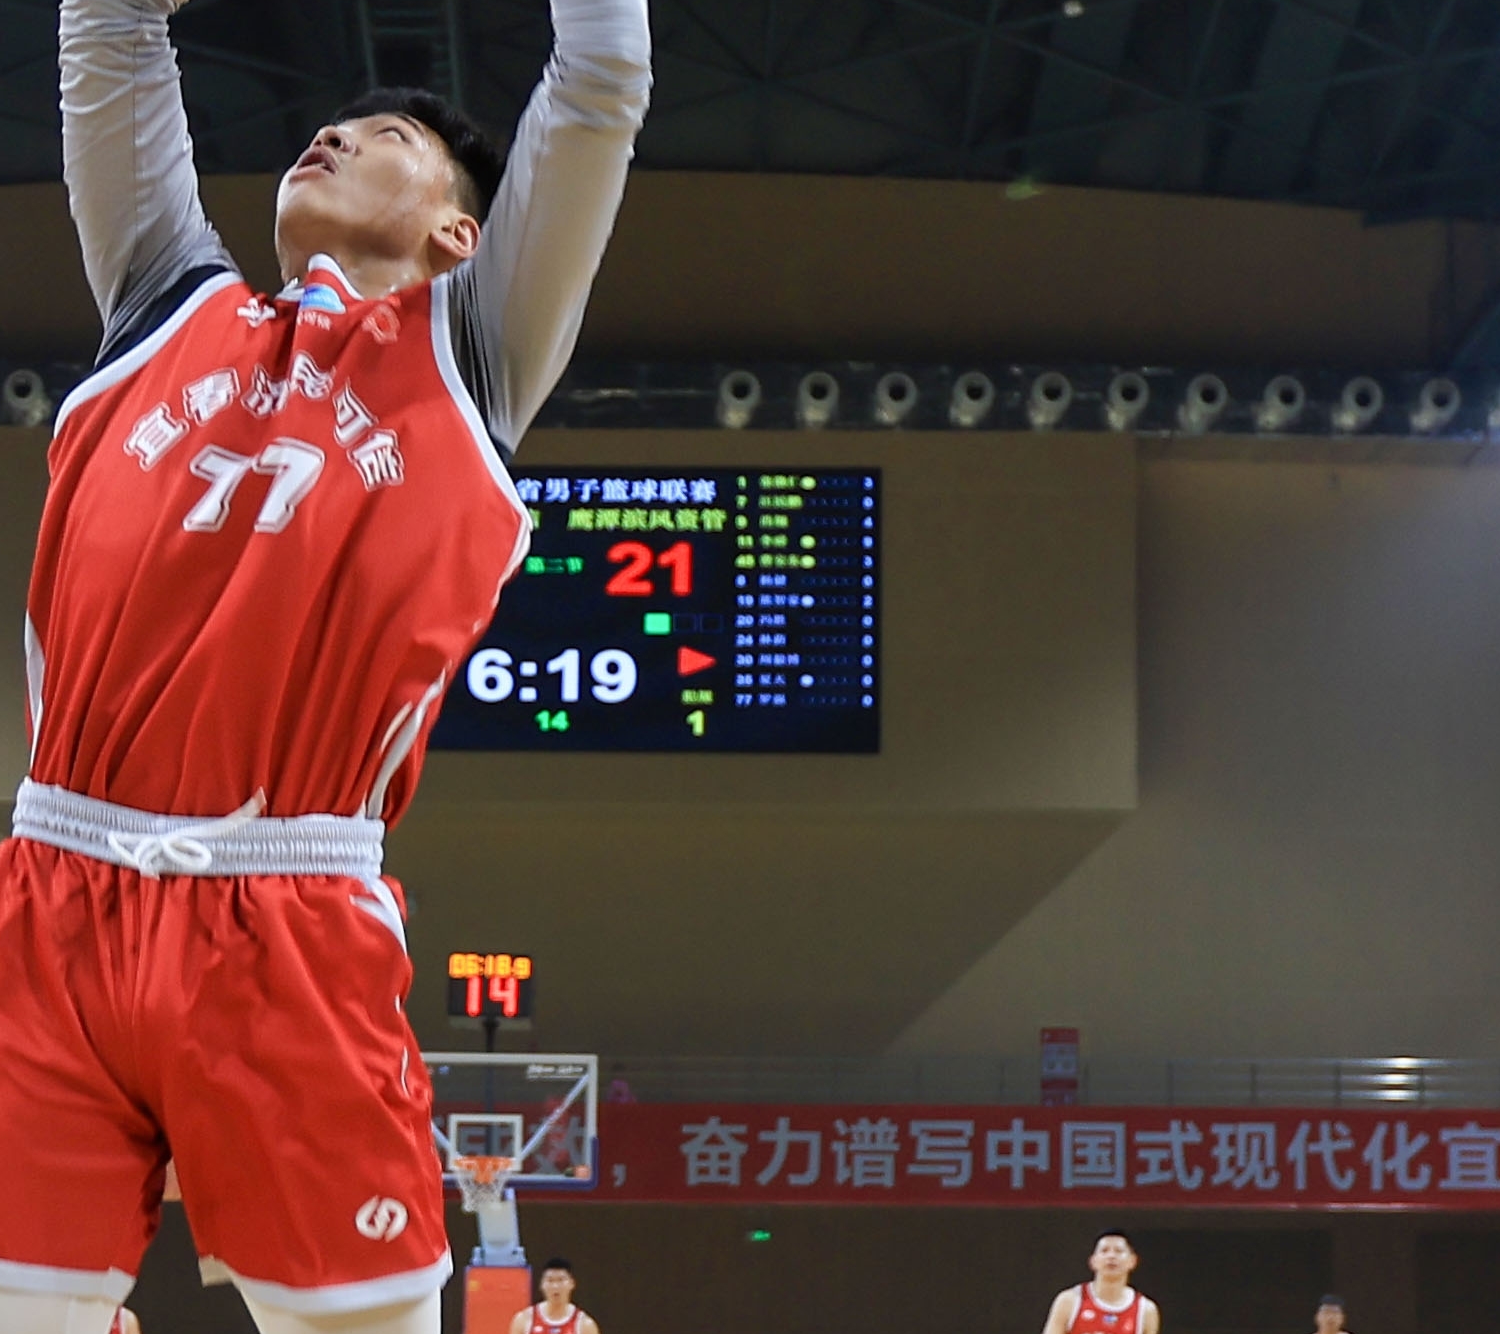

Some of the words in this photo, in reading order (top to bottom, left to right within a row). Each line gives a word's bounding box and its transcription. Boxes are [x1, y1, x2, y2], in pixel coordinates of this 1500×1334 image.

[183, 437, 326, 534] 77
[605, 540, 694, 597] 21
[467, 648, 638, 703] 6:19
[535, 710, 569, 731] 14
[686, 710, 705, 737] 1
[466, 976, 519, 1017] 14
